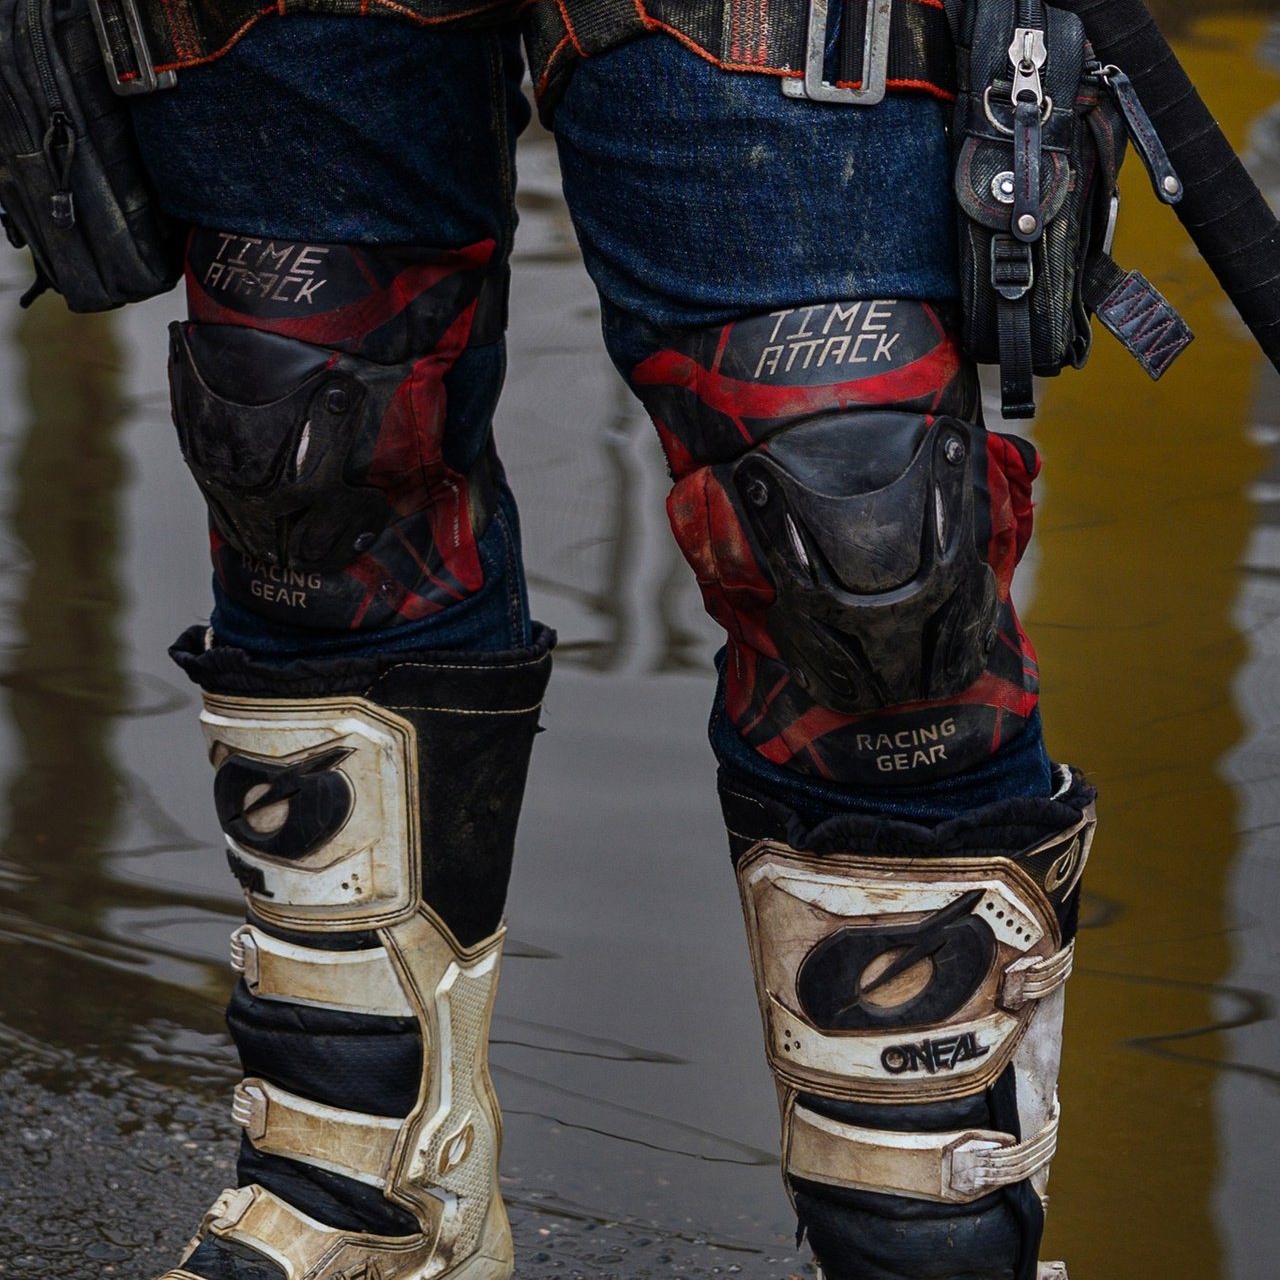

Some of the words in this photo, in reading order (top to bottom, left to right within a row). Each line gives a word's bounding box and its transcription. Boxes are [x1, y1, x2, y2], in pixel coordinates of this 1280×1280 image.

[216, 232, 329, 276] TIME
[203, 263, 327, 304] ATTACK
[766, 300, 897, 343] TIME
[754, 333, 900, 378] ATTACK
[241, 552, 321, 590] RACING
[251, 581, 307, 609] GEAR
[857, 718, 956, 751] RACING
[878, 745, 947, 771] GEAR
